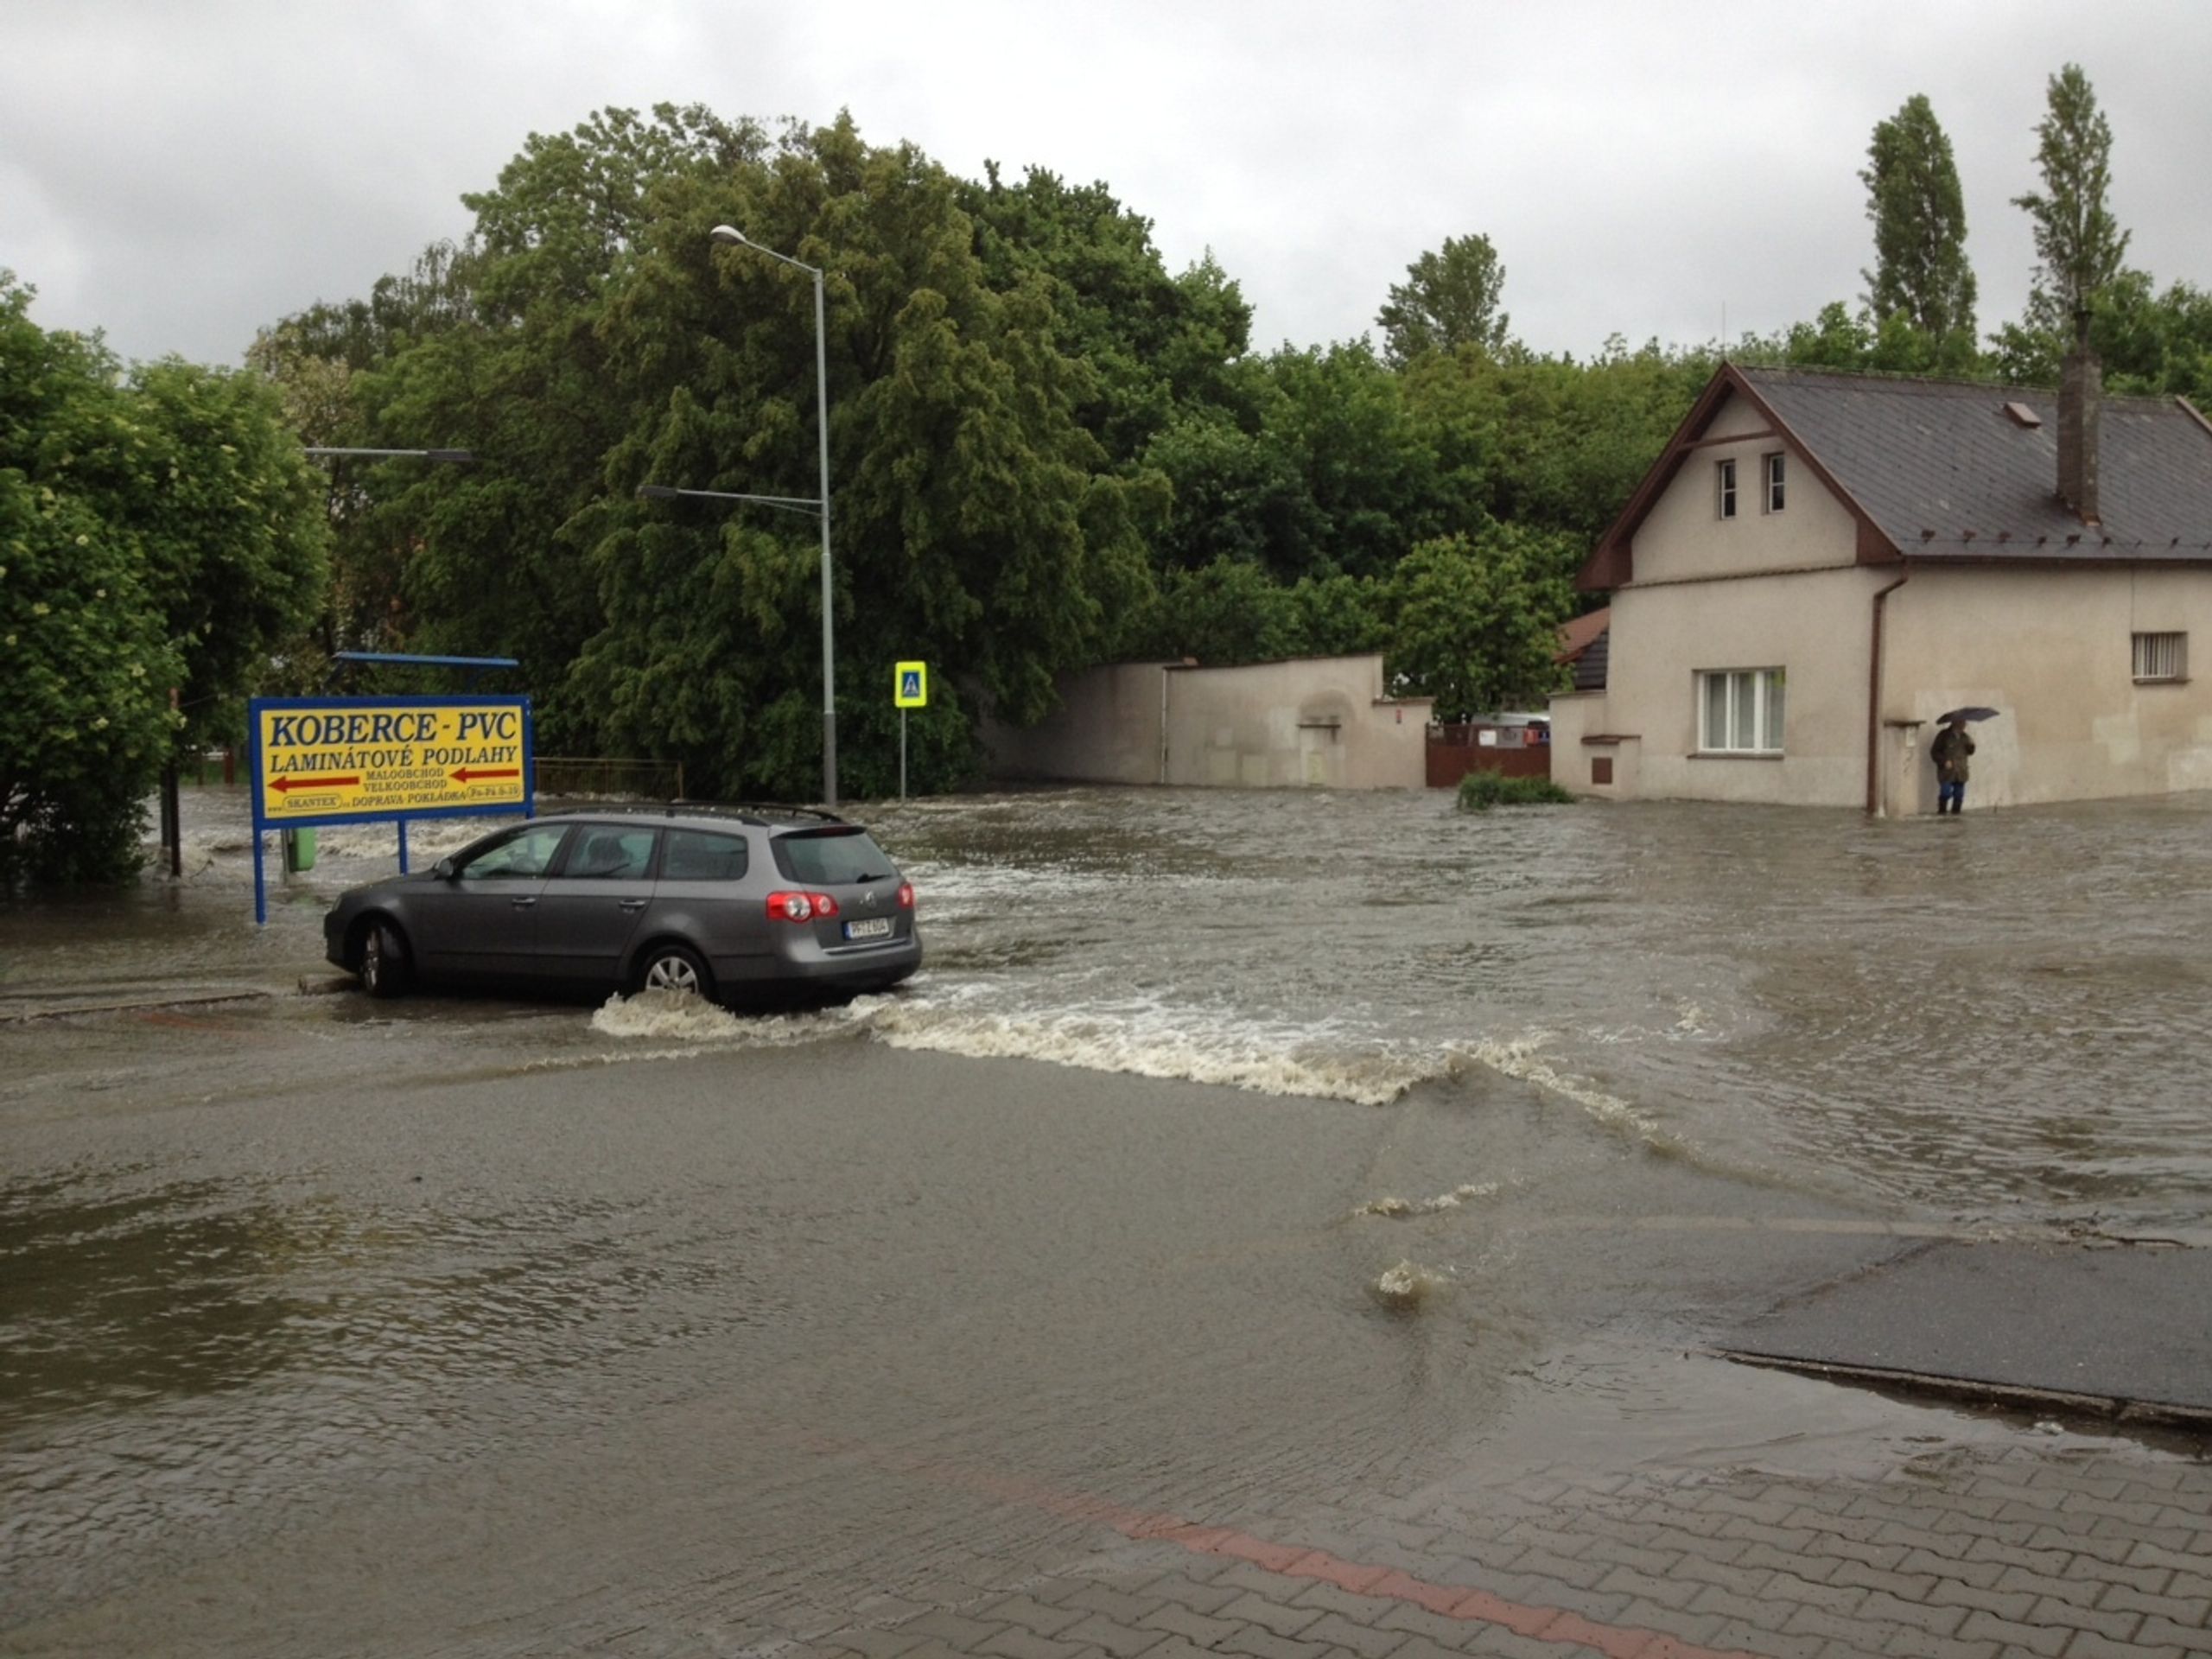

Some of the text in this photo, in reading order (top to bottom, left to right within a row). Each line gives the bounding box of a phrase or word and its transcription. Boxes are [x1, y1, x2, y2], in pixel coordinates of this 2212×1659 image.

[269, 714, 437, 746] KOBERCE
[456, 712, 517, 741] PVC
[270, 745, 517, 772] LAMINÁTOVÉ PODLAHY
[365, 767, 445, 780] MALOOBCHOD
[362, 779, 448, 792] VELKOOBCHOD
[287, 798, 336, 809] SKANTEX
[353, 796, 404, 807] DOPRAVA
[408, 791, 467, 804] POKLÁDKA
